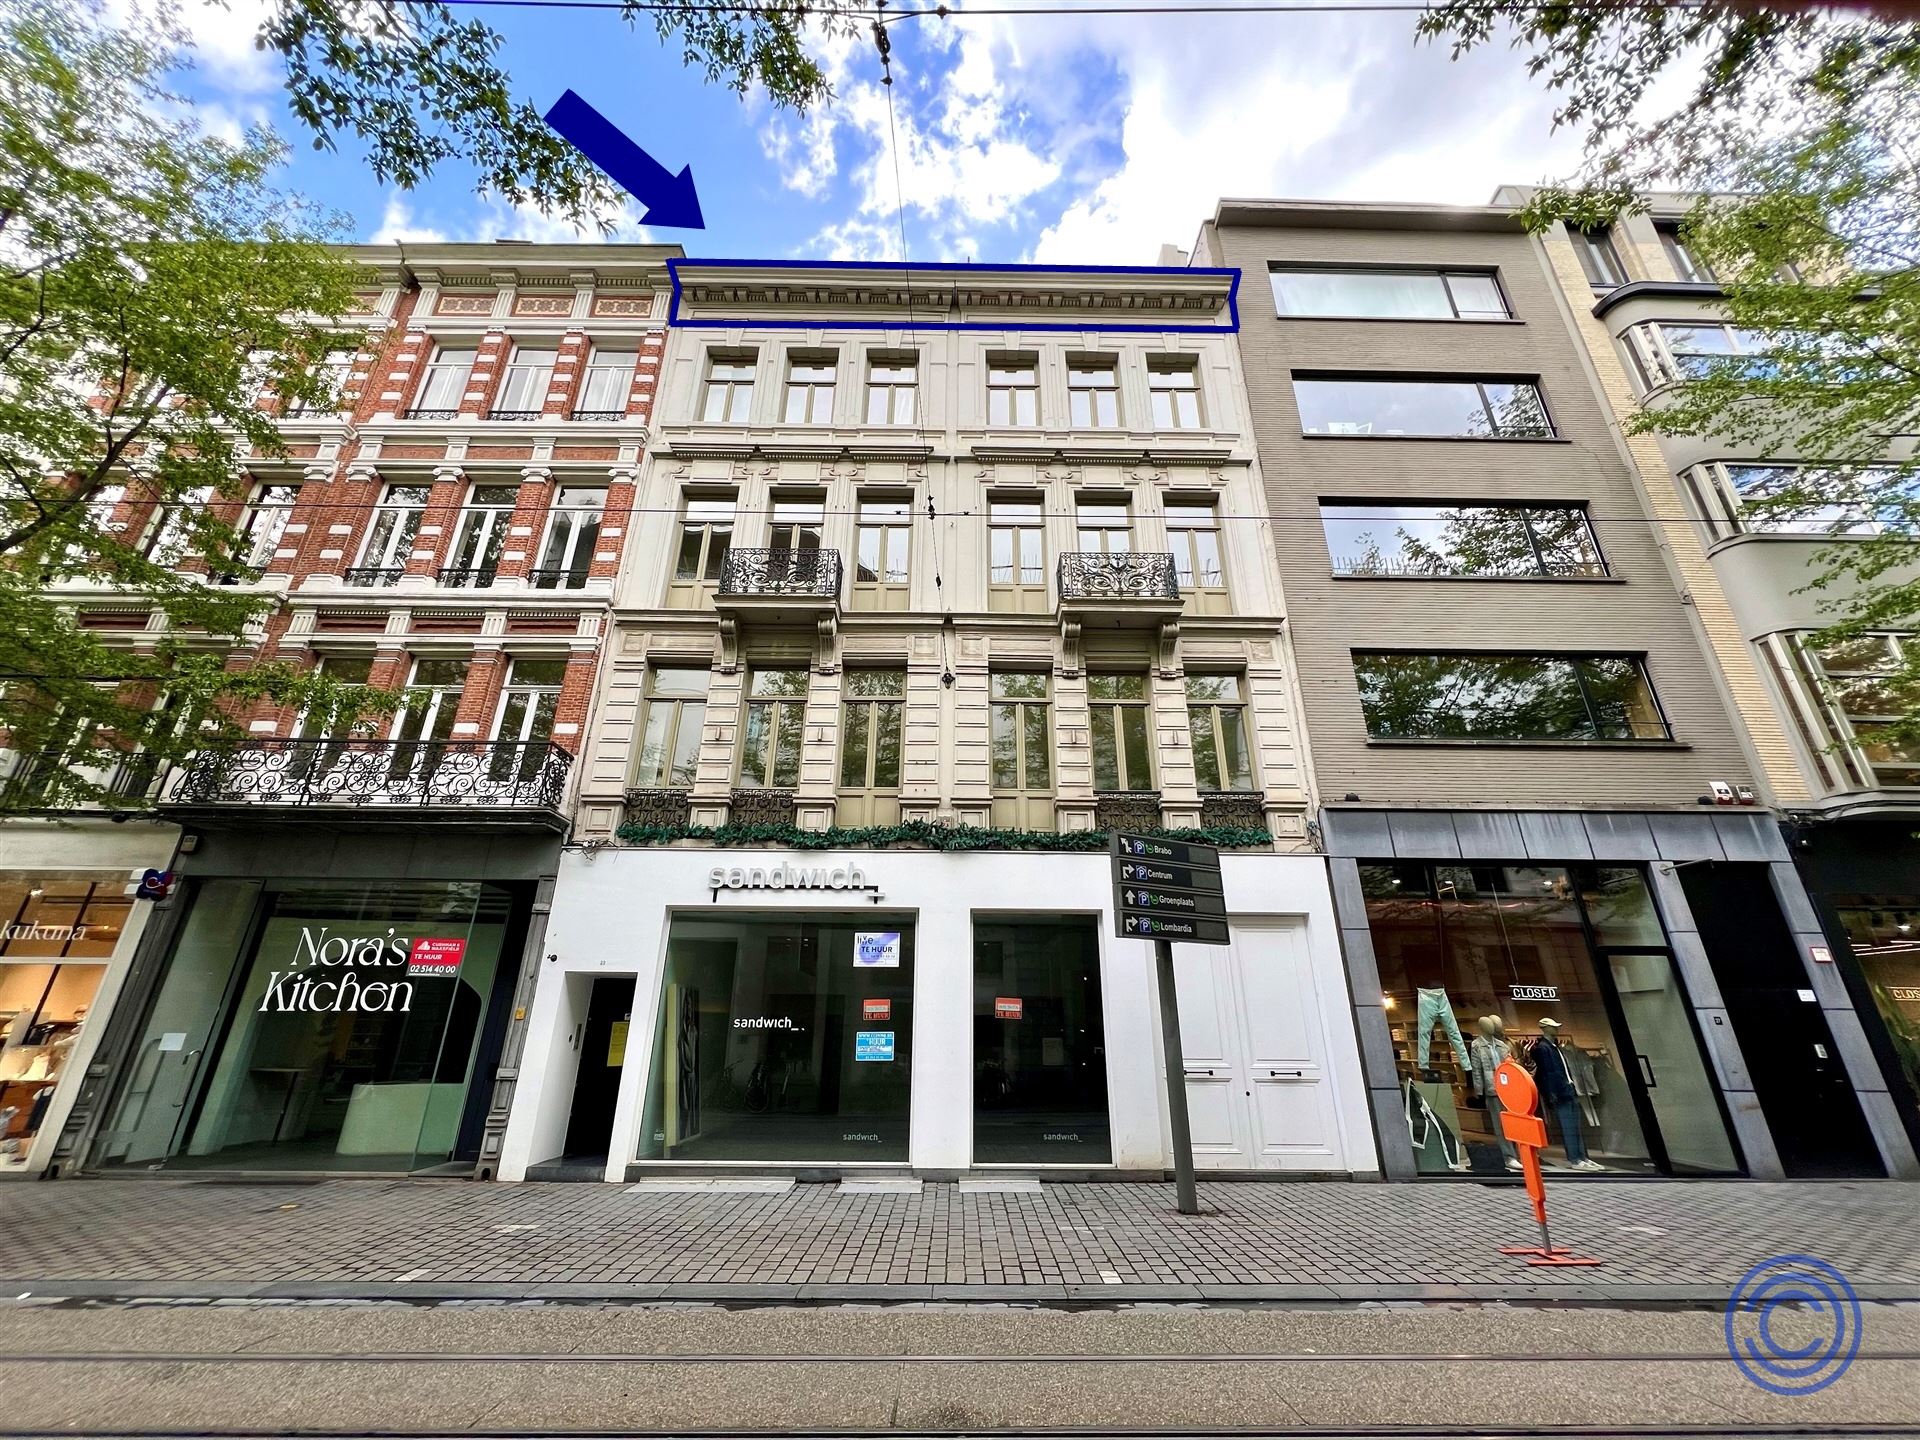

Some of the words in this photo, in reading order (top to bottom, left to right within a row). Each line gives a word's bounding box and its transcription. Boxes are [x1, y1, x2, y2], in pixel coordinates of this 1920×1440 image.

[1154, 845, 1172, 855] Brabo
[1147, 869, 1173, 879] Centrum
[1159, 895, 1195, 907] Groenplaats
[1160, 922, 1192, 933] Lombardia
[290, 927, 409, 967] Nora's
[410, 965, 420, 973] 02
[421, 965, 433, 973] 514
[434, 965, 445, 973] 40
[445, 966, 456, 974] 00
[257, 971, 414, 1011] Kitchen
[1512, 987, 1556, 999] CLOSED
